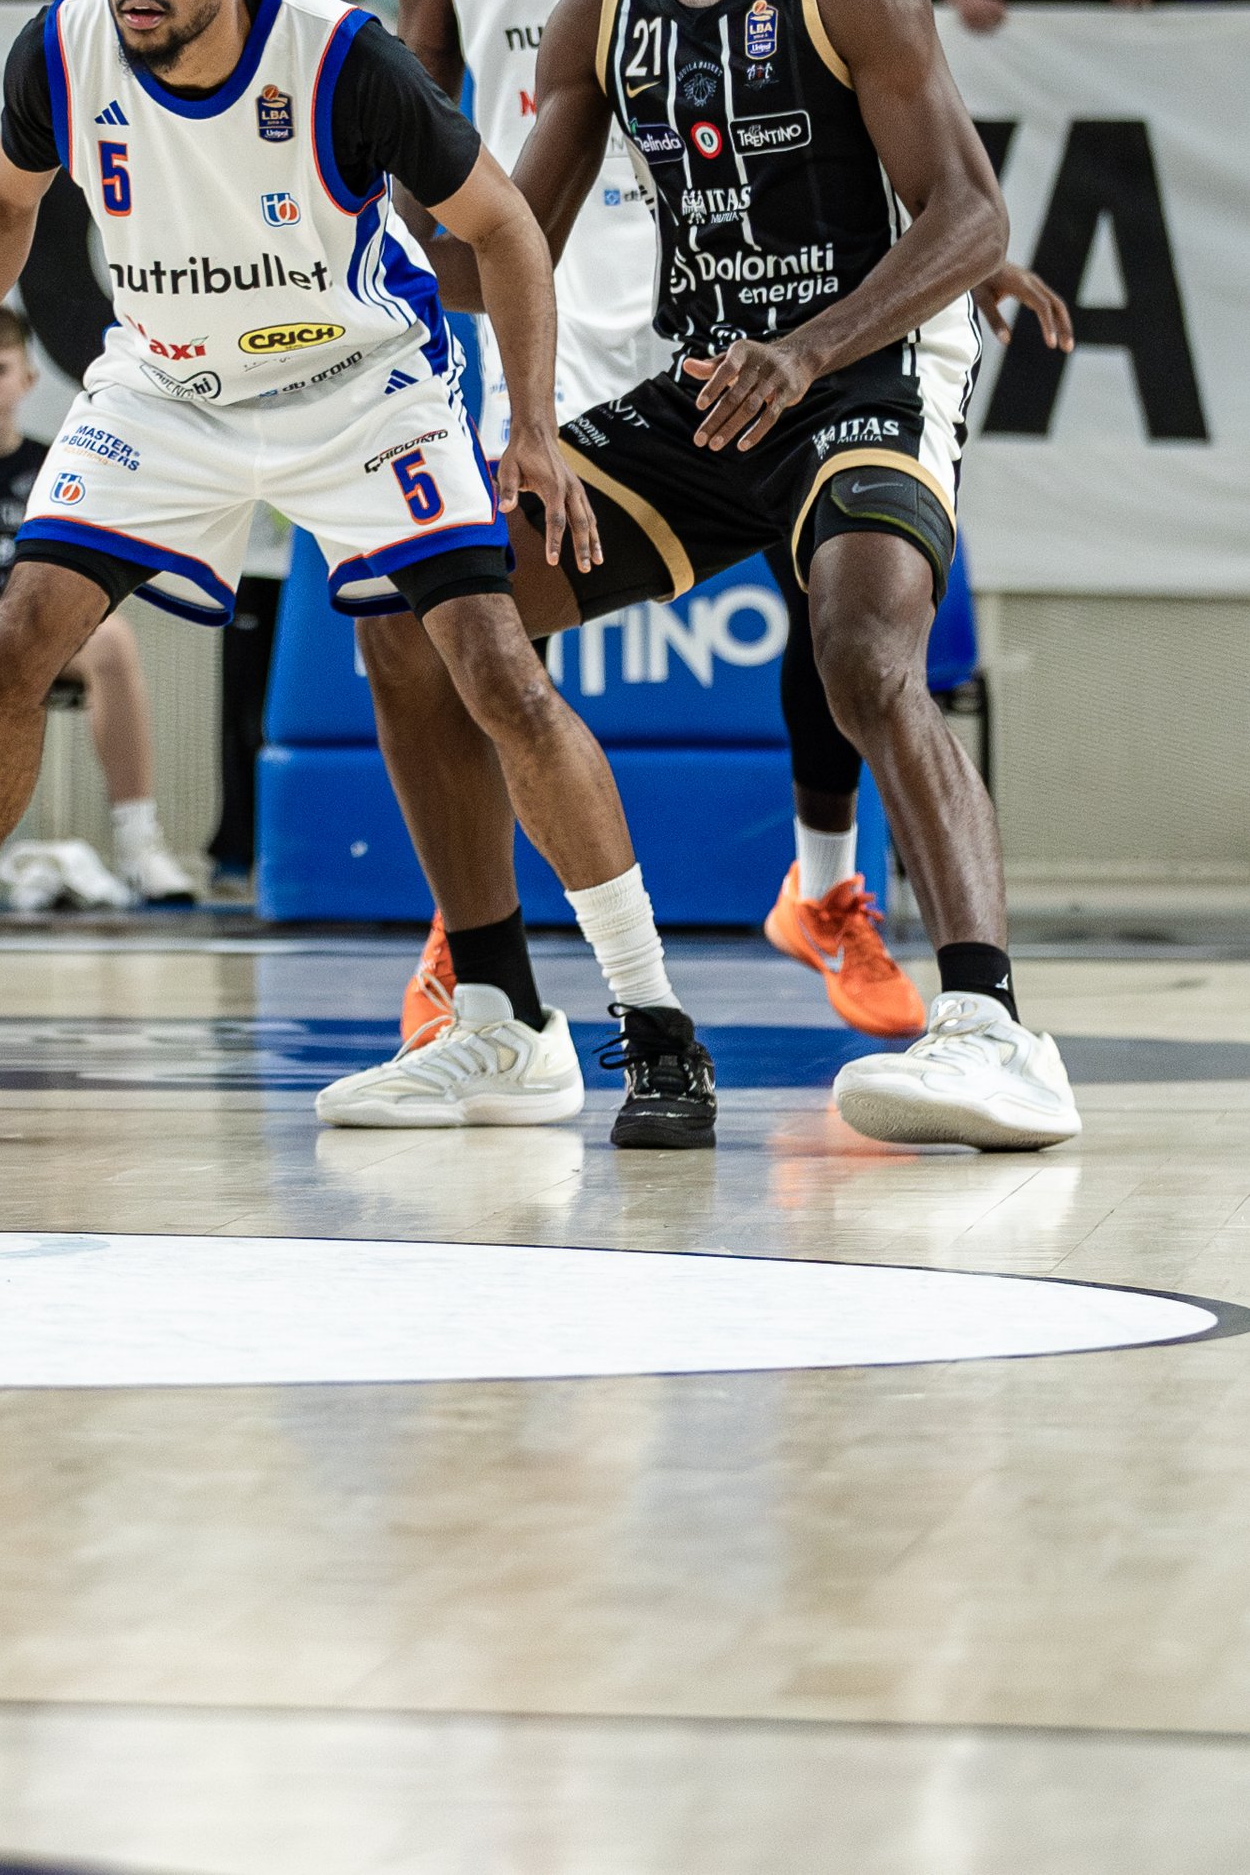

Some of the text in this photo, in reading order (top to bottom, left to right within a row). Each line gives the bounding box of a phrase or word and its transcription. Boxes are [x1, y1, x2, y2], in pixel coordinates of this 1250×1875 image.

[749, 22, 773, 35] LBA
[625, 16, 662, 77] 21
[261, 110, 290, 120] LBA
[737, 124, 802, 147] TRENTINO
[97, 140, 132, 216] 5
[706, 186, 750, 212] ITAS
[695, 242, 834, 282] Dolomiti
[738, 275, 840, 304] energia
[248, 327, 335, 350] CRICH
[75, 425, 134, 457] MASTER
[839, 417, 900, 437] ITAS
[69, 435, 140, 471] BUILDERS
[391, 447, 445, 526] 5
